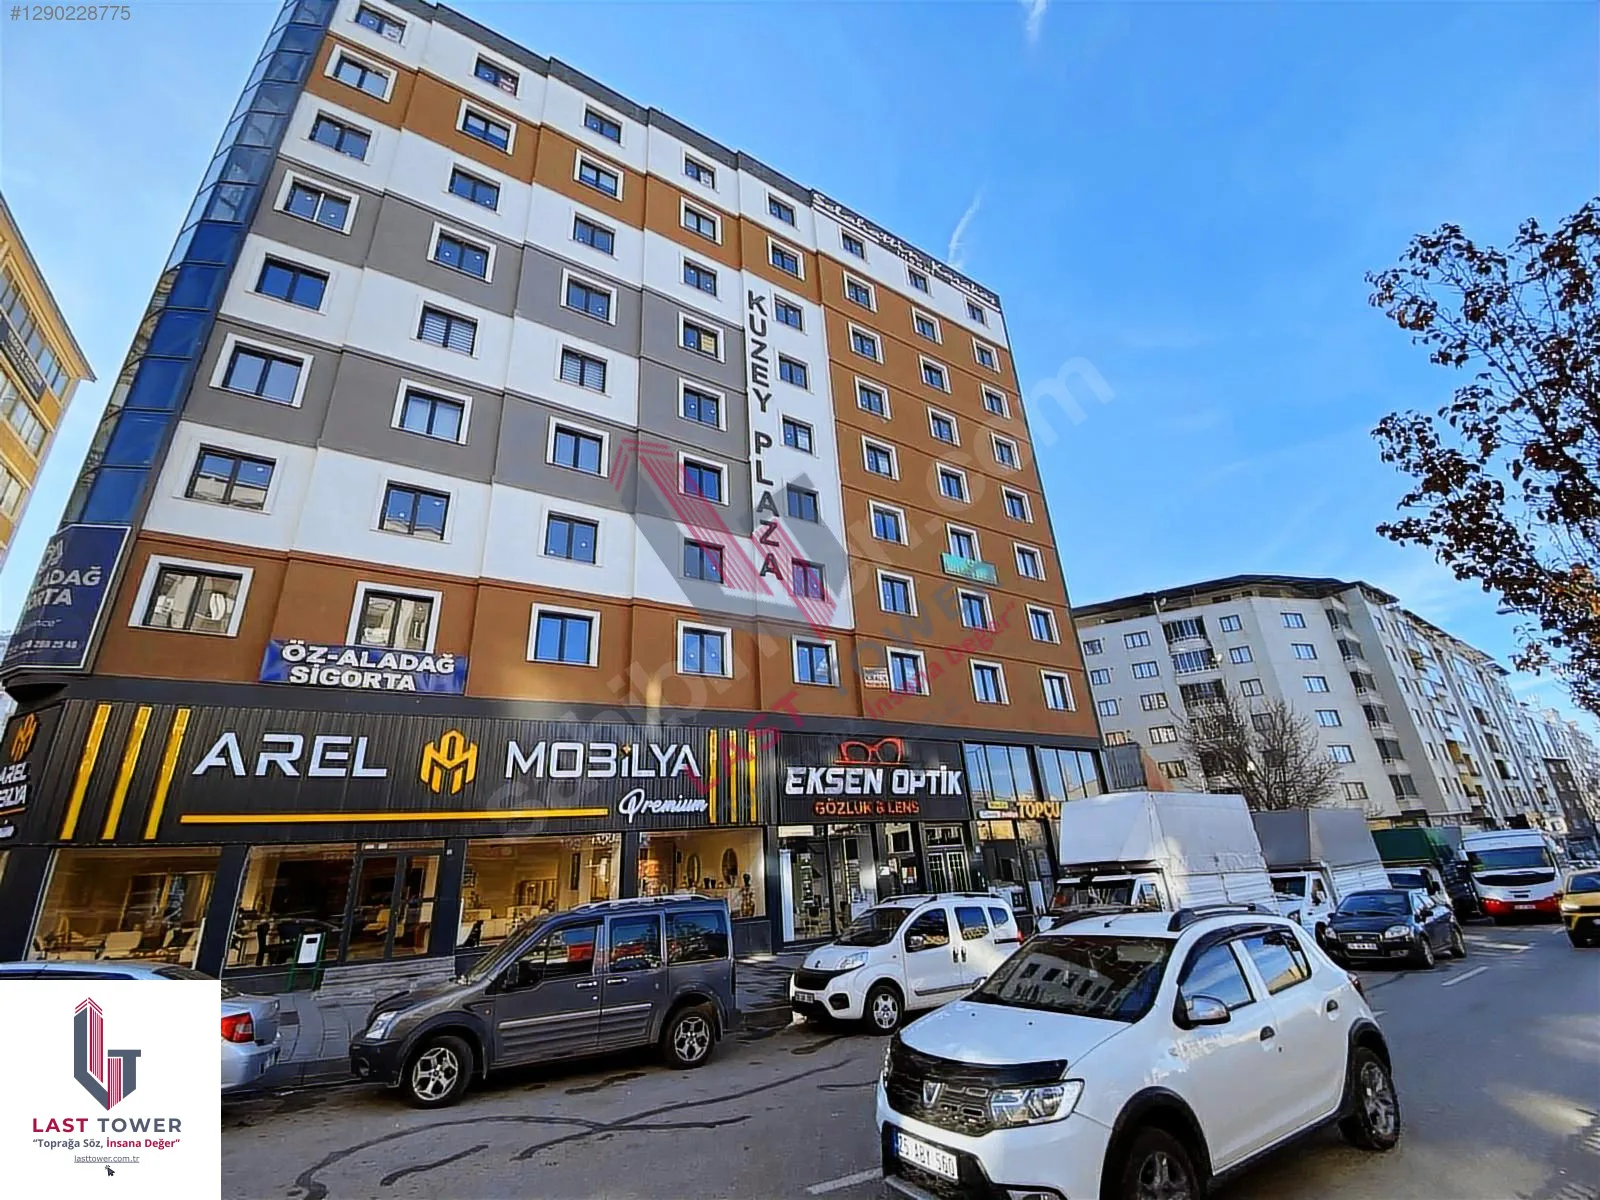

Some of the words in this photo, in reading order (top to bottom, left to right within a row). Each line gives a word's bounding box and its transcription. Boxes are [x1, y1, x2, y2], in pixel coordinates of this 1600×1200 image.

[748, 290, 772, 413] KUZEY
[755, 430, 784, 581] PLAZA
[281, 639, 456, 674] ÖZ-ALADAĞ
[289, 664, 417, 692] SİGORTA
[192, 732, 388, 778] AREL
[504, 740, 702, 778] MOBİLYA
[785, 766, 885, 796] EKSEN
[891, 764, 963, 796] OPTİK
[618, 788, 708, 824] Premium
[887, 800, 921, 814] LENS
